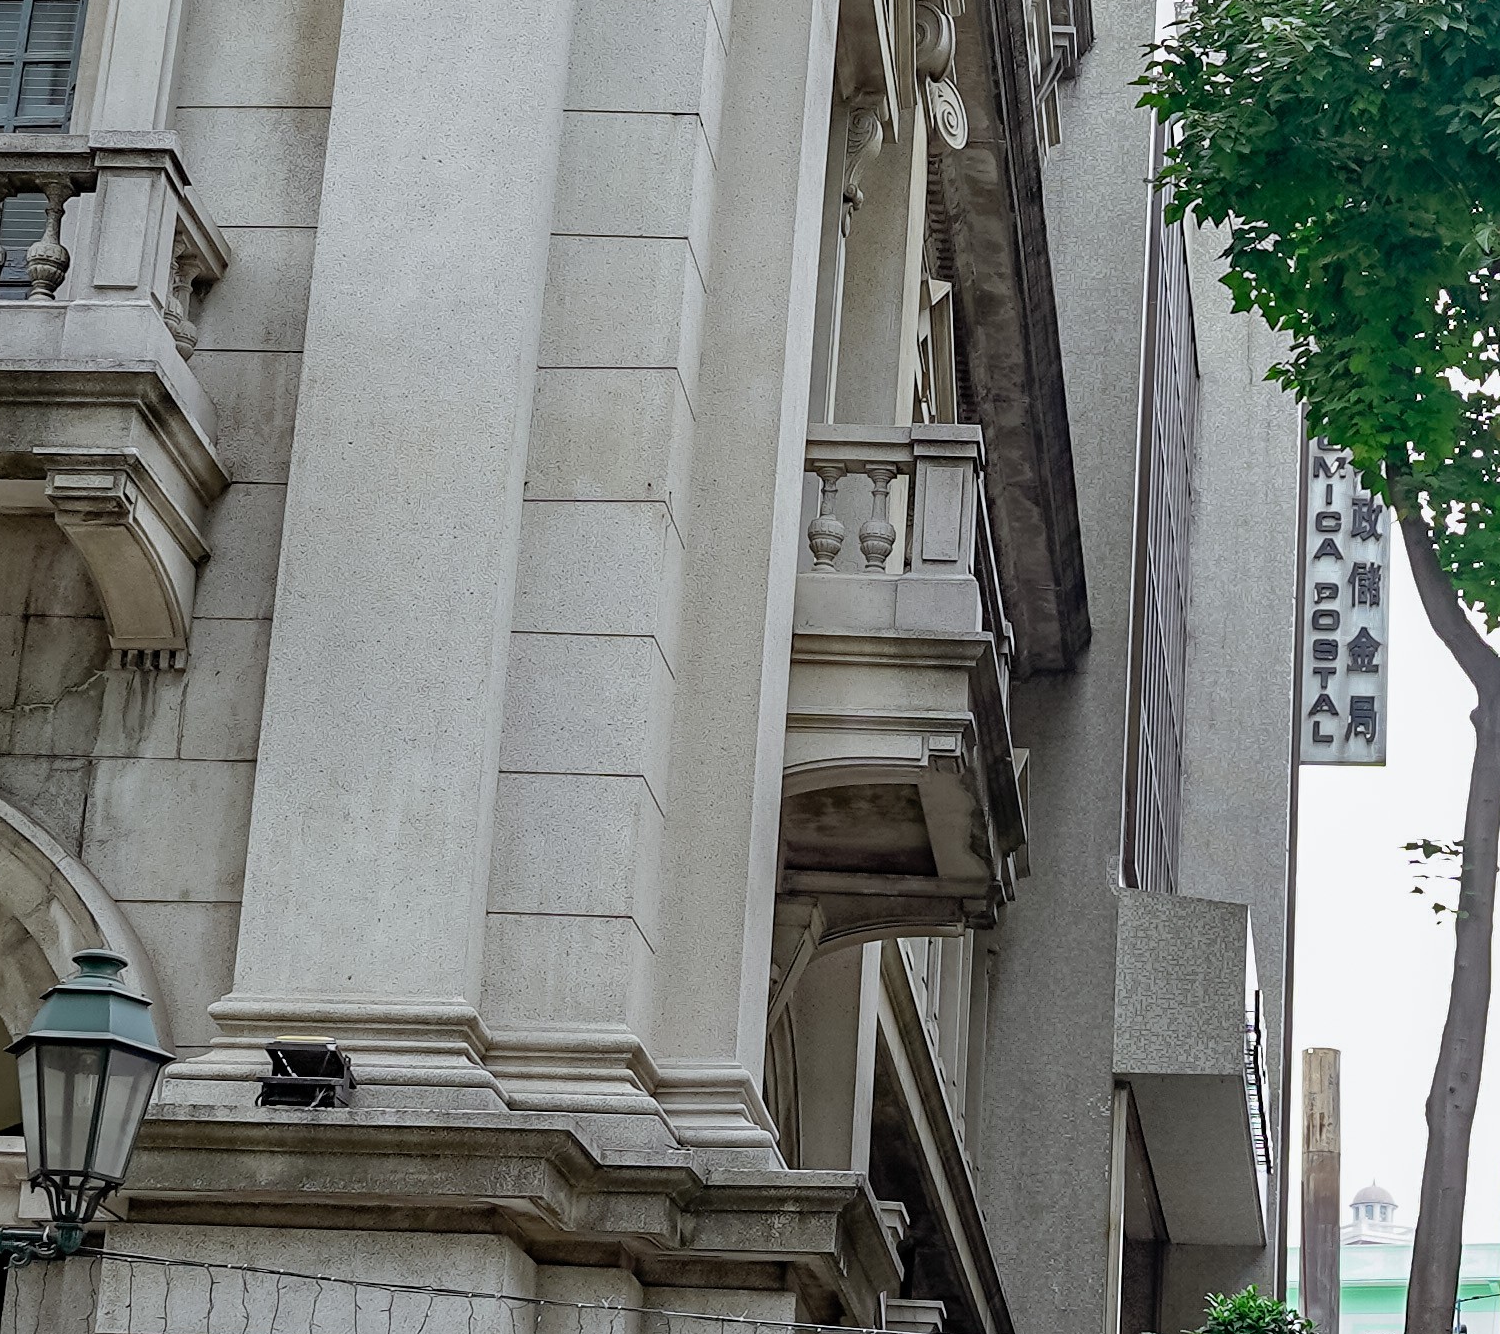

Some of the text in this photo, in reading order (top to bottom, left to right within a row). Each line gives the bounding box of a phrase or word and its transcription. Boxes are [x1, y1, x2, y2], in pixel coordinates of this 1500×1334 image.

[1308, 582, 1340, 743] POSTAL
[1345, 475, 1382, 744] 政儲金局
